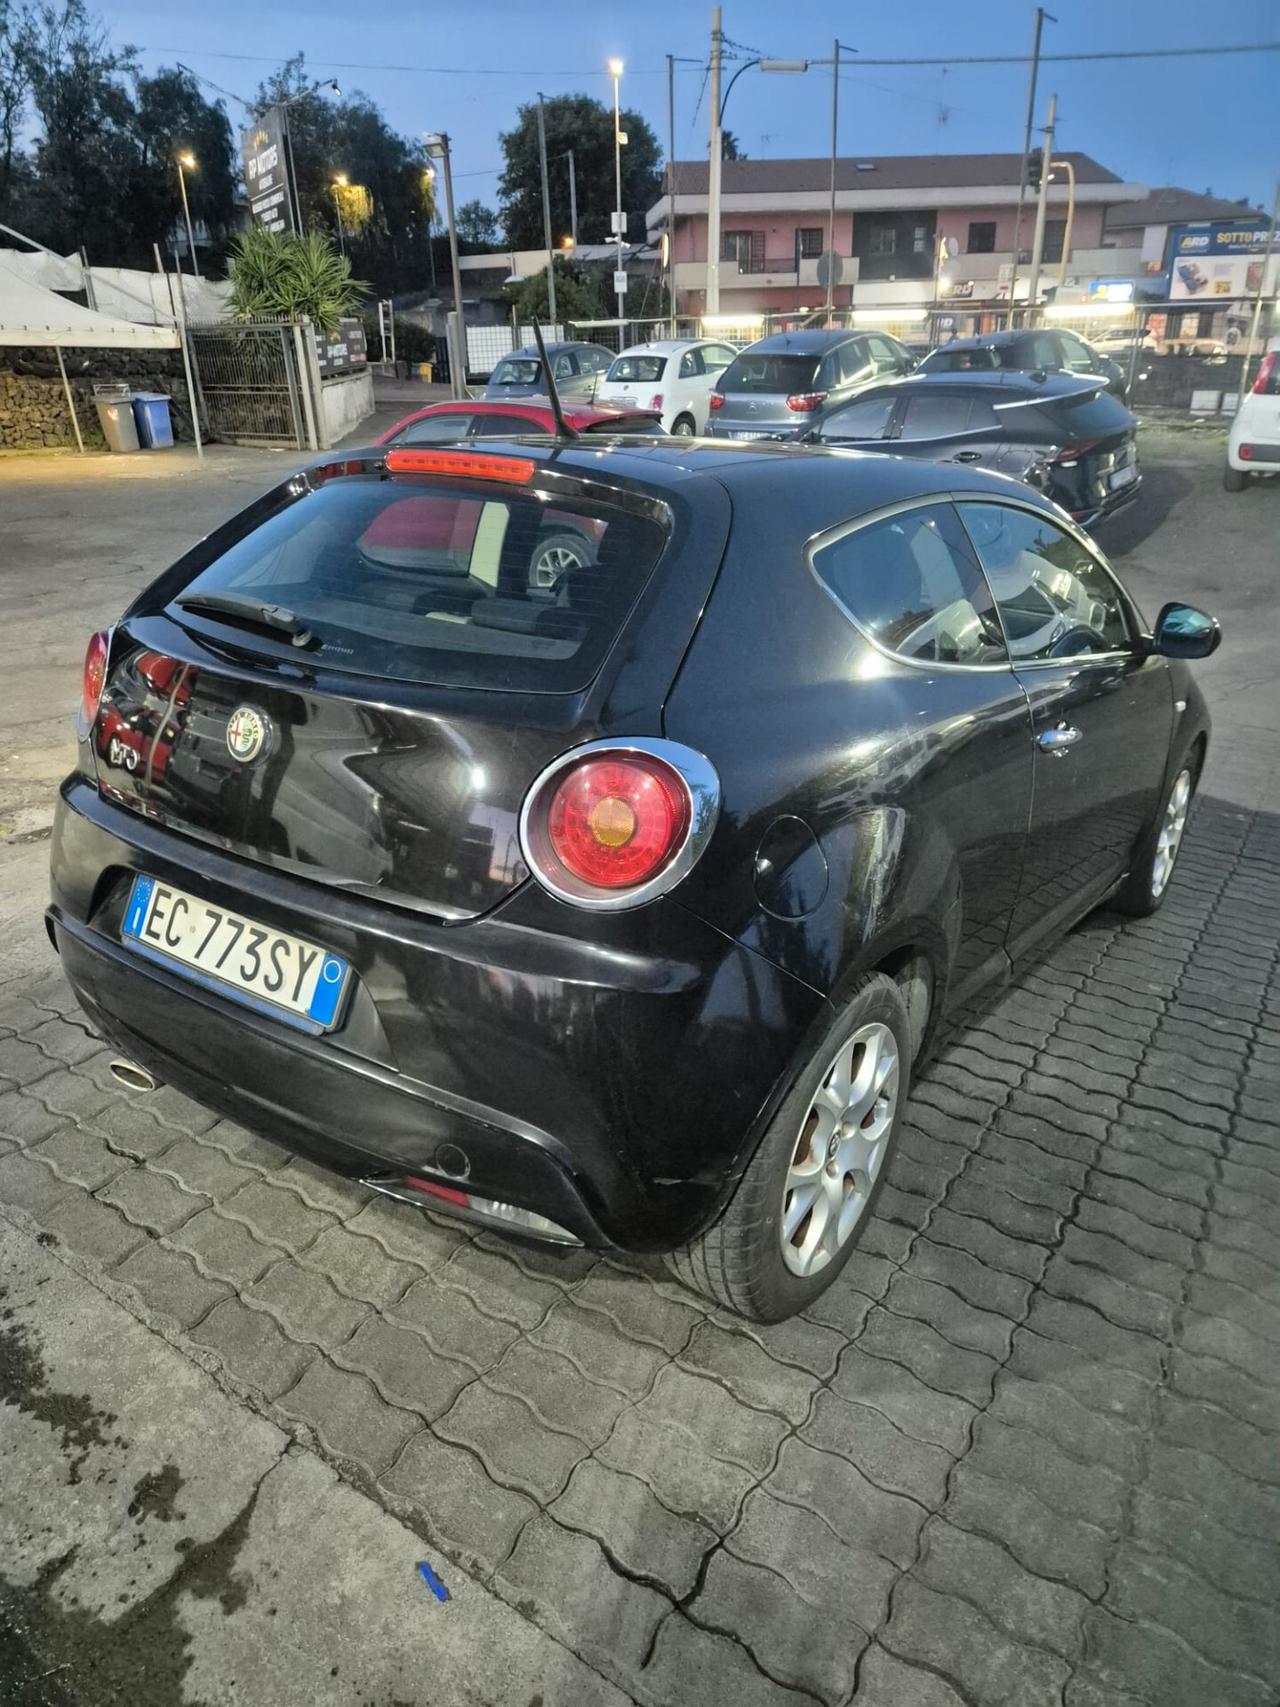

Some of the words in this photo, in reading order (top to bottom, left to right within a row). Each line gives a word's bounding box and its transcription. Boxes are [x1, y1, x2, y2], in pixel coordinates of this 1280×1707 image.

[1181, 236, 1209, 249] ARD
[145, 887, 189, 947] EC
[194, 909, 318, 1002] 773SY
